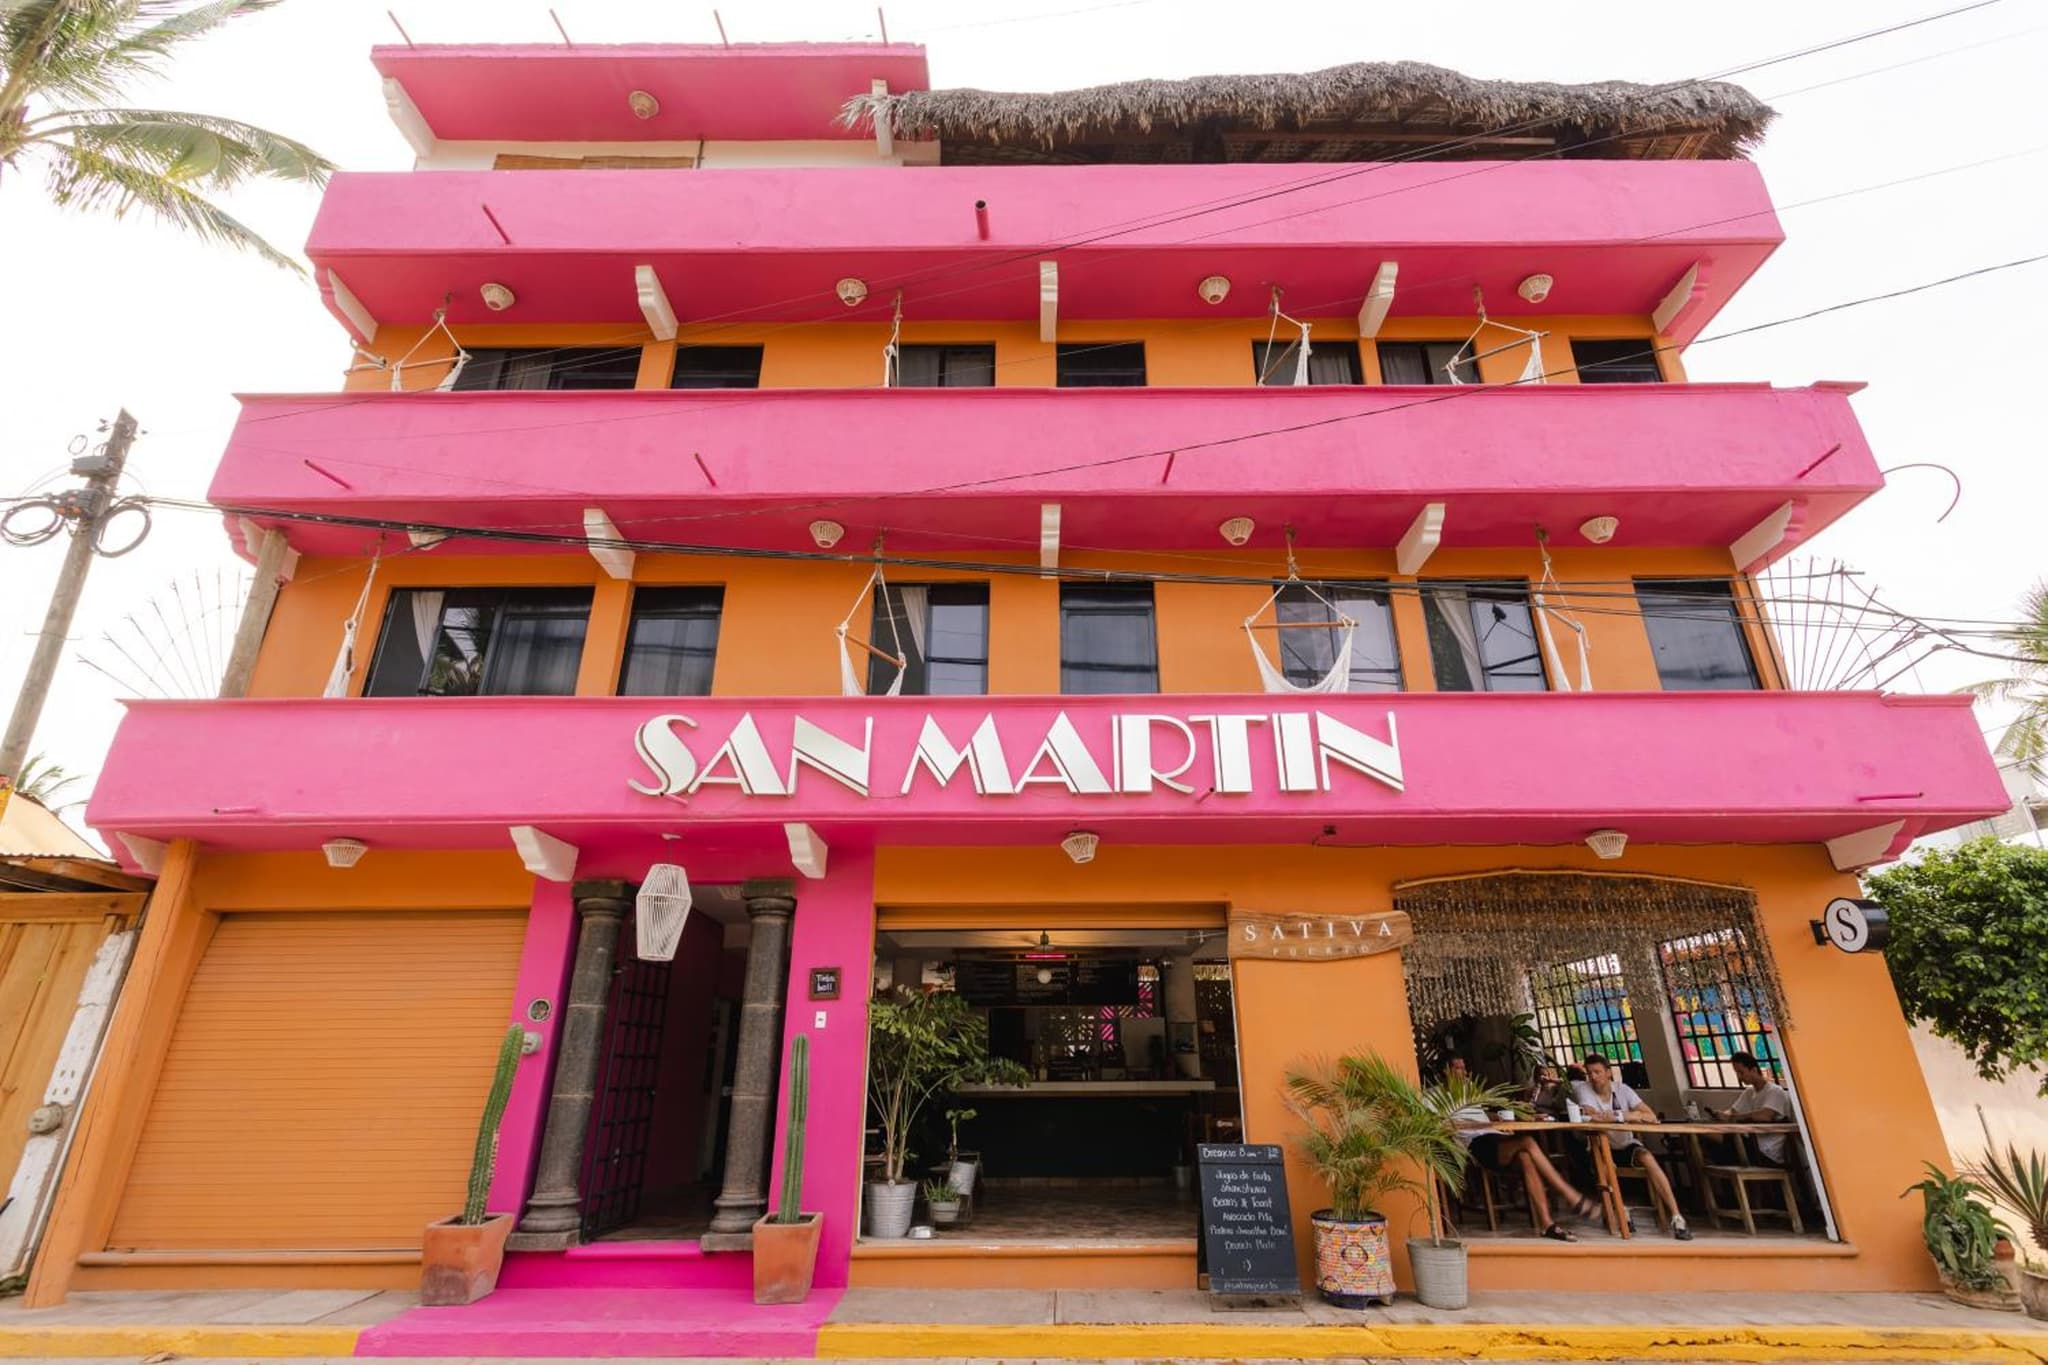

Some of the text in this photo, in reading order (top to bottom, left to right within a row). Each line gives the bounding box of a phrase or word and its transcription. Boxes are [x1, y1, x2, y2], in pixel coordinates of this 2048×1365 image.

[627, 711, 1404, 797] SAN MARTIN
[1245, 922, 1392, 941] SATIVA
[1836, 907, 1858, 942] S
[1273, 946, 1369, 956] PUERTO
[1239, 1170, 1250, 1180] de
